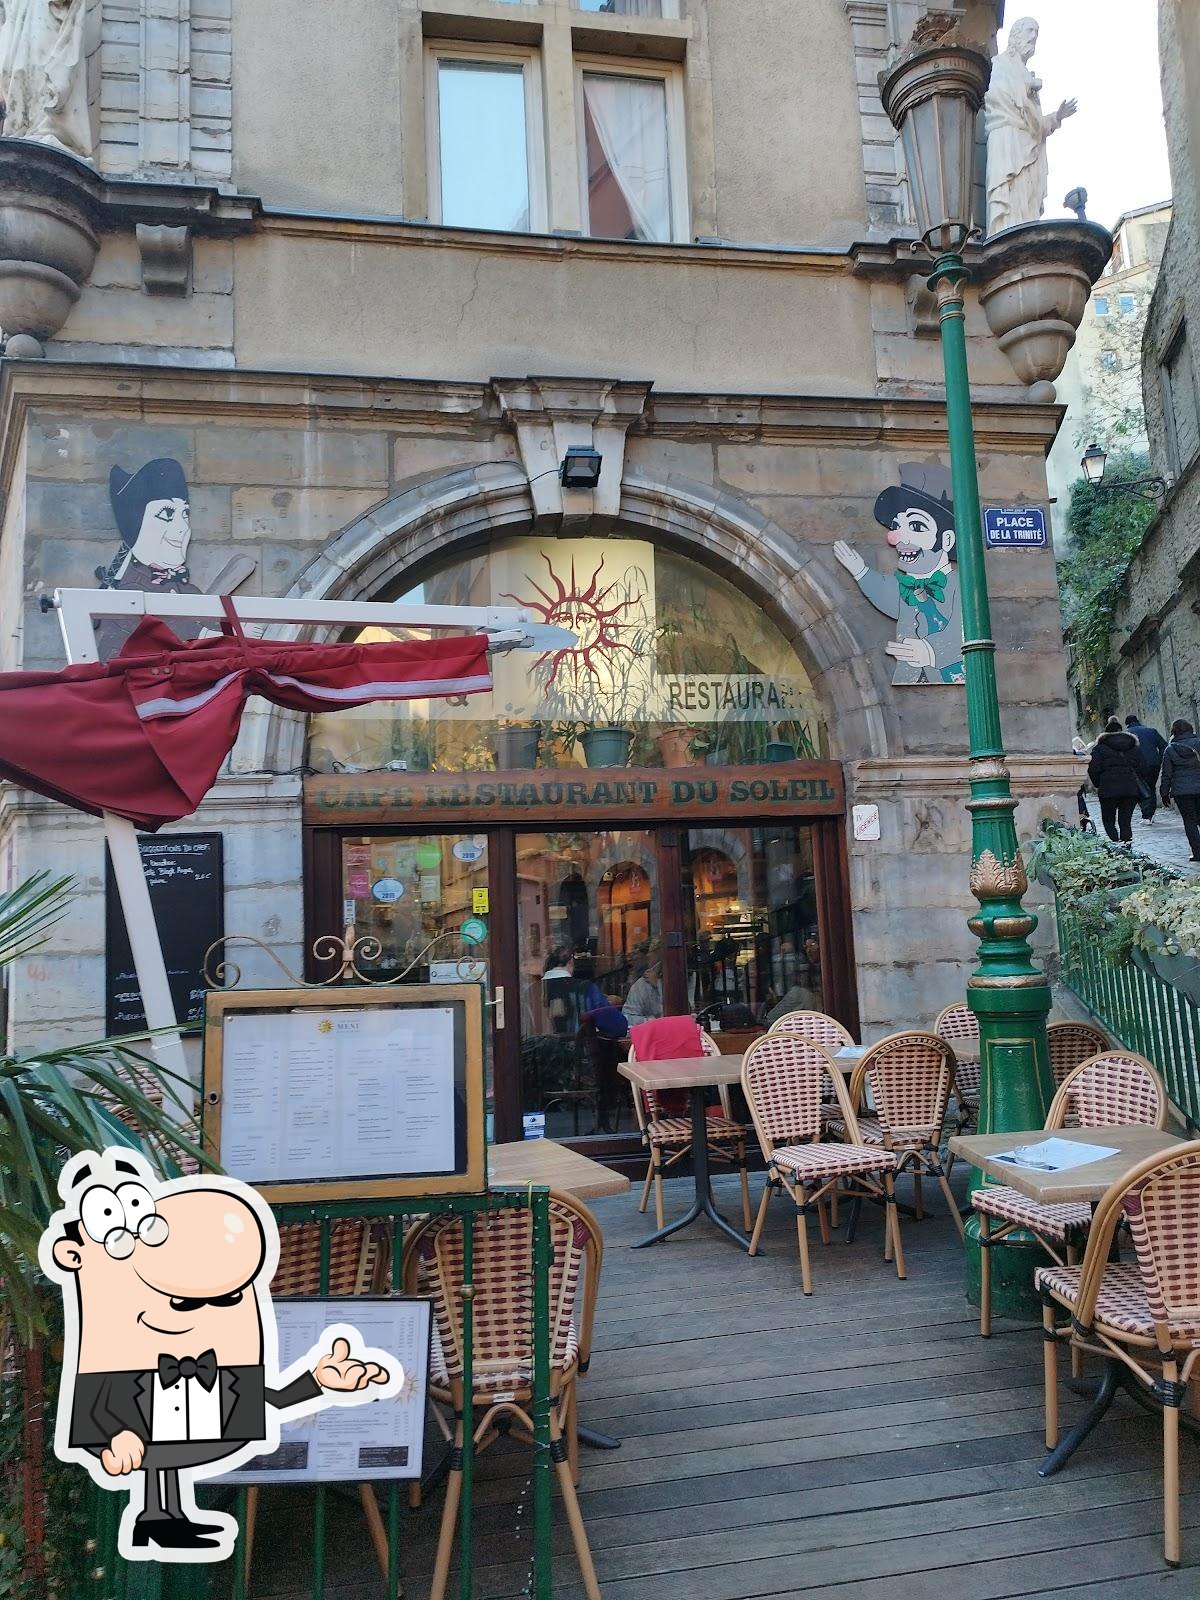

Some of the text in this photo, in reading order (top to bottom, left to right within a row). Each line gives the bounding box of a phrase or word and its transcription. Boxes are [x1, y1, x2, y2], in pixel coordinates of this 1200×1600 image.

[996, 517, 1034, 527] PLACE
[990, 529, 1042, 540] DE LA TRINITÉ
[669, 681, 803, 711] RESTAURA
[421, 781, 658, 810] RESTAURANT
[671, 780, 720, 805] DU
[729, 778, 836, 805] SOLEIL
